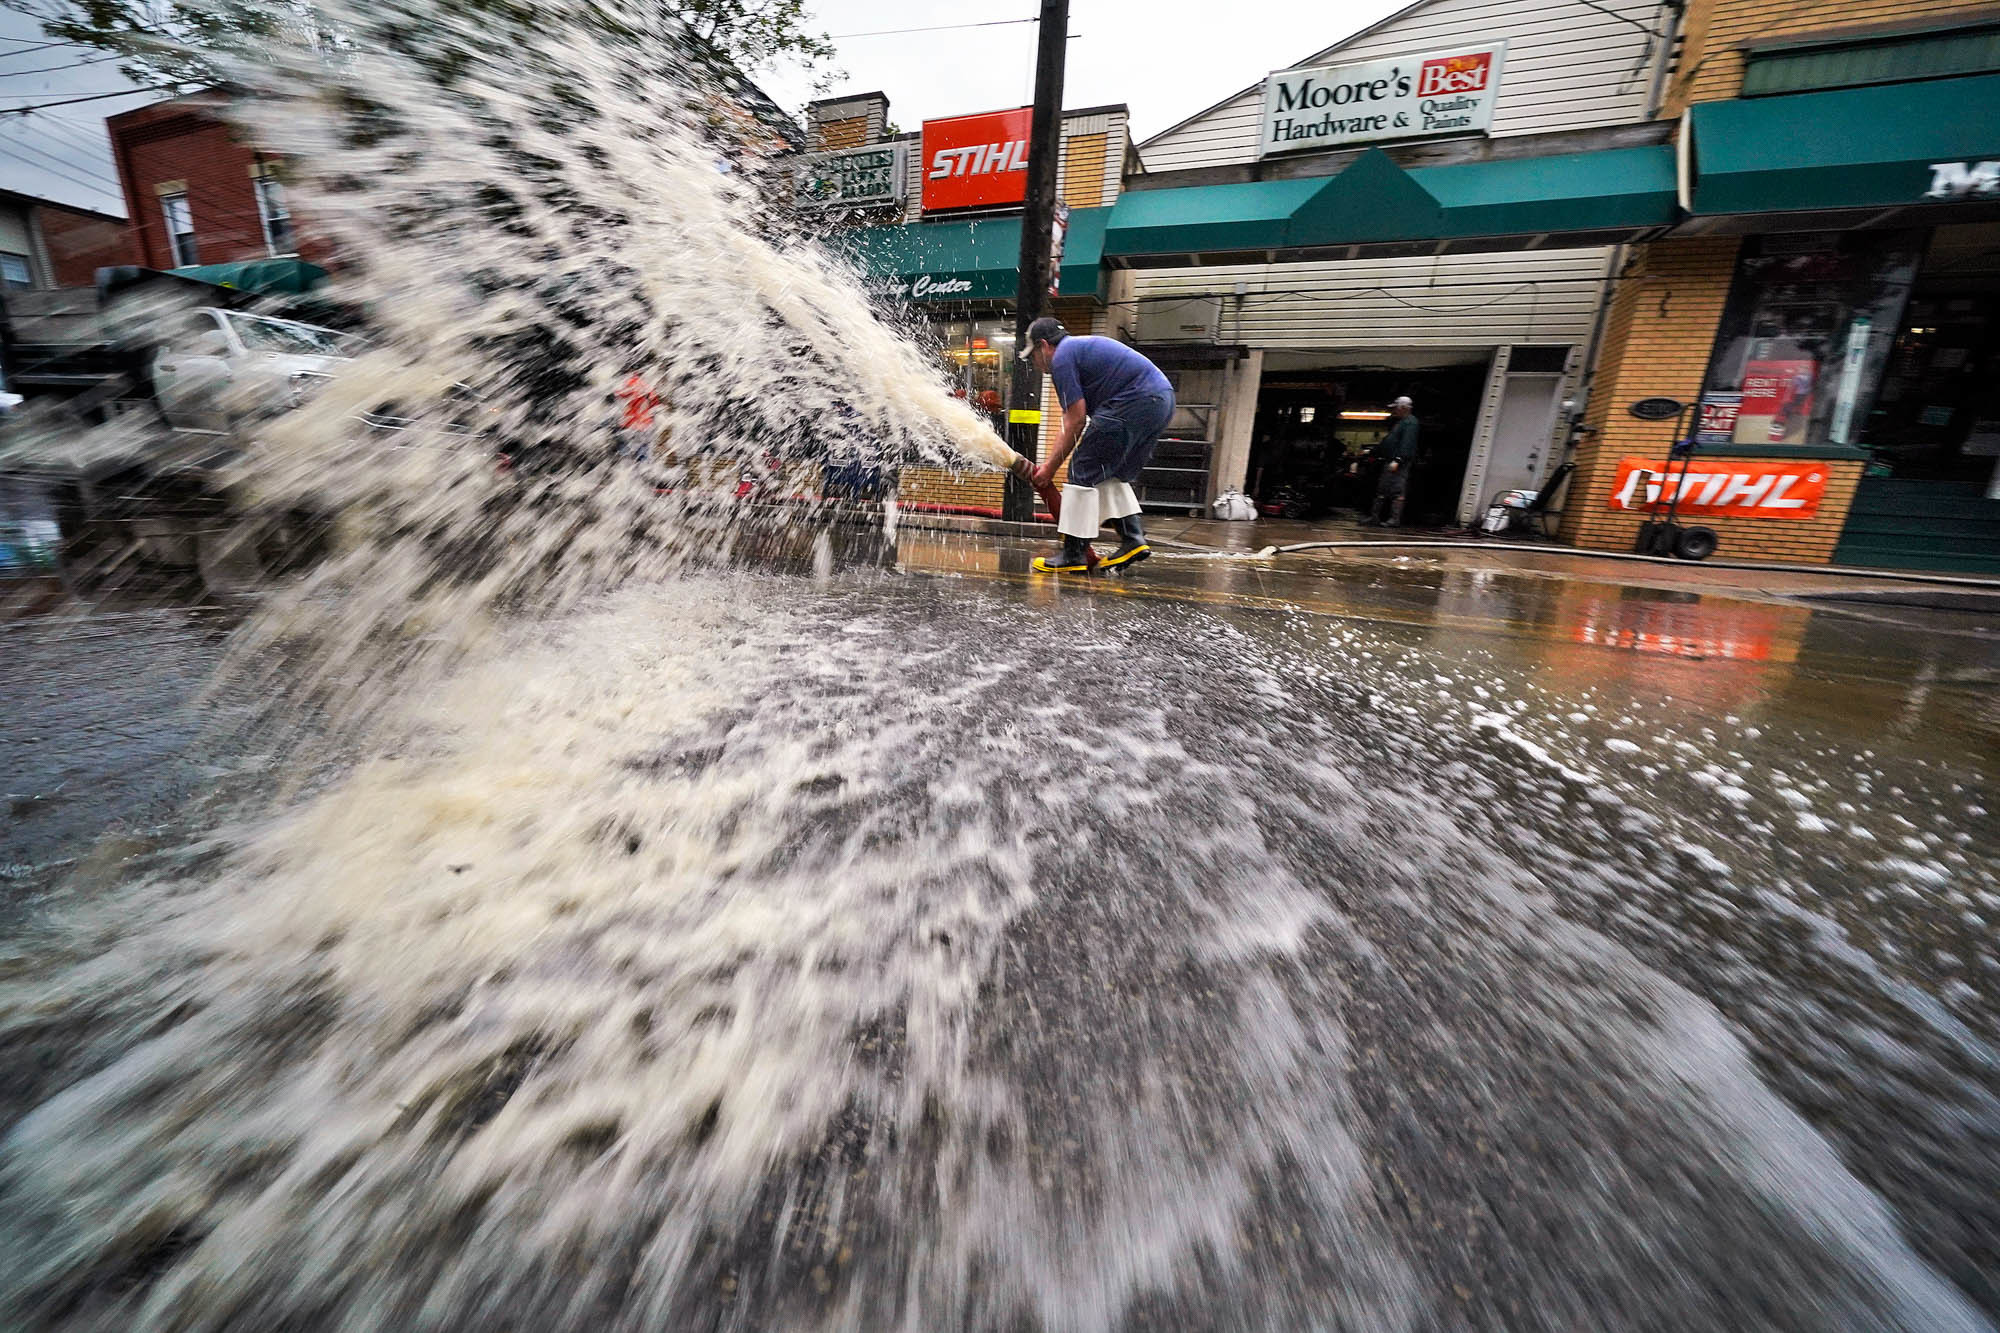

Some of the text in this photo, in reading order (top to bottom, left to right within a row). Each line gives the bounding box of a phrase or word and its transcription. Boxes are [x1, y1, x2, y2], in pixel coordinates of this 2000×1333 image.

[1274, 67, 1411, 113] Moore's
[1420, 63, 1488, 95] Best
[1420, 96, 1481, 115] Quality
[1272, 111, 1410, 142] Hardware &
[1423, 115, 1471, 130] Paints
[929, 140, 1029, 180] STIHL
[911, 276, 973, 298] Center
